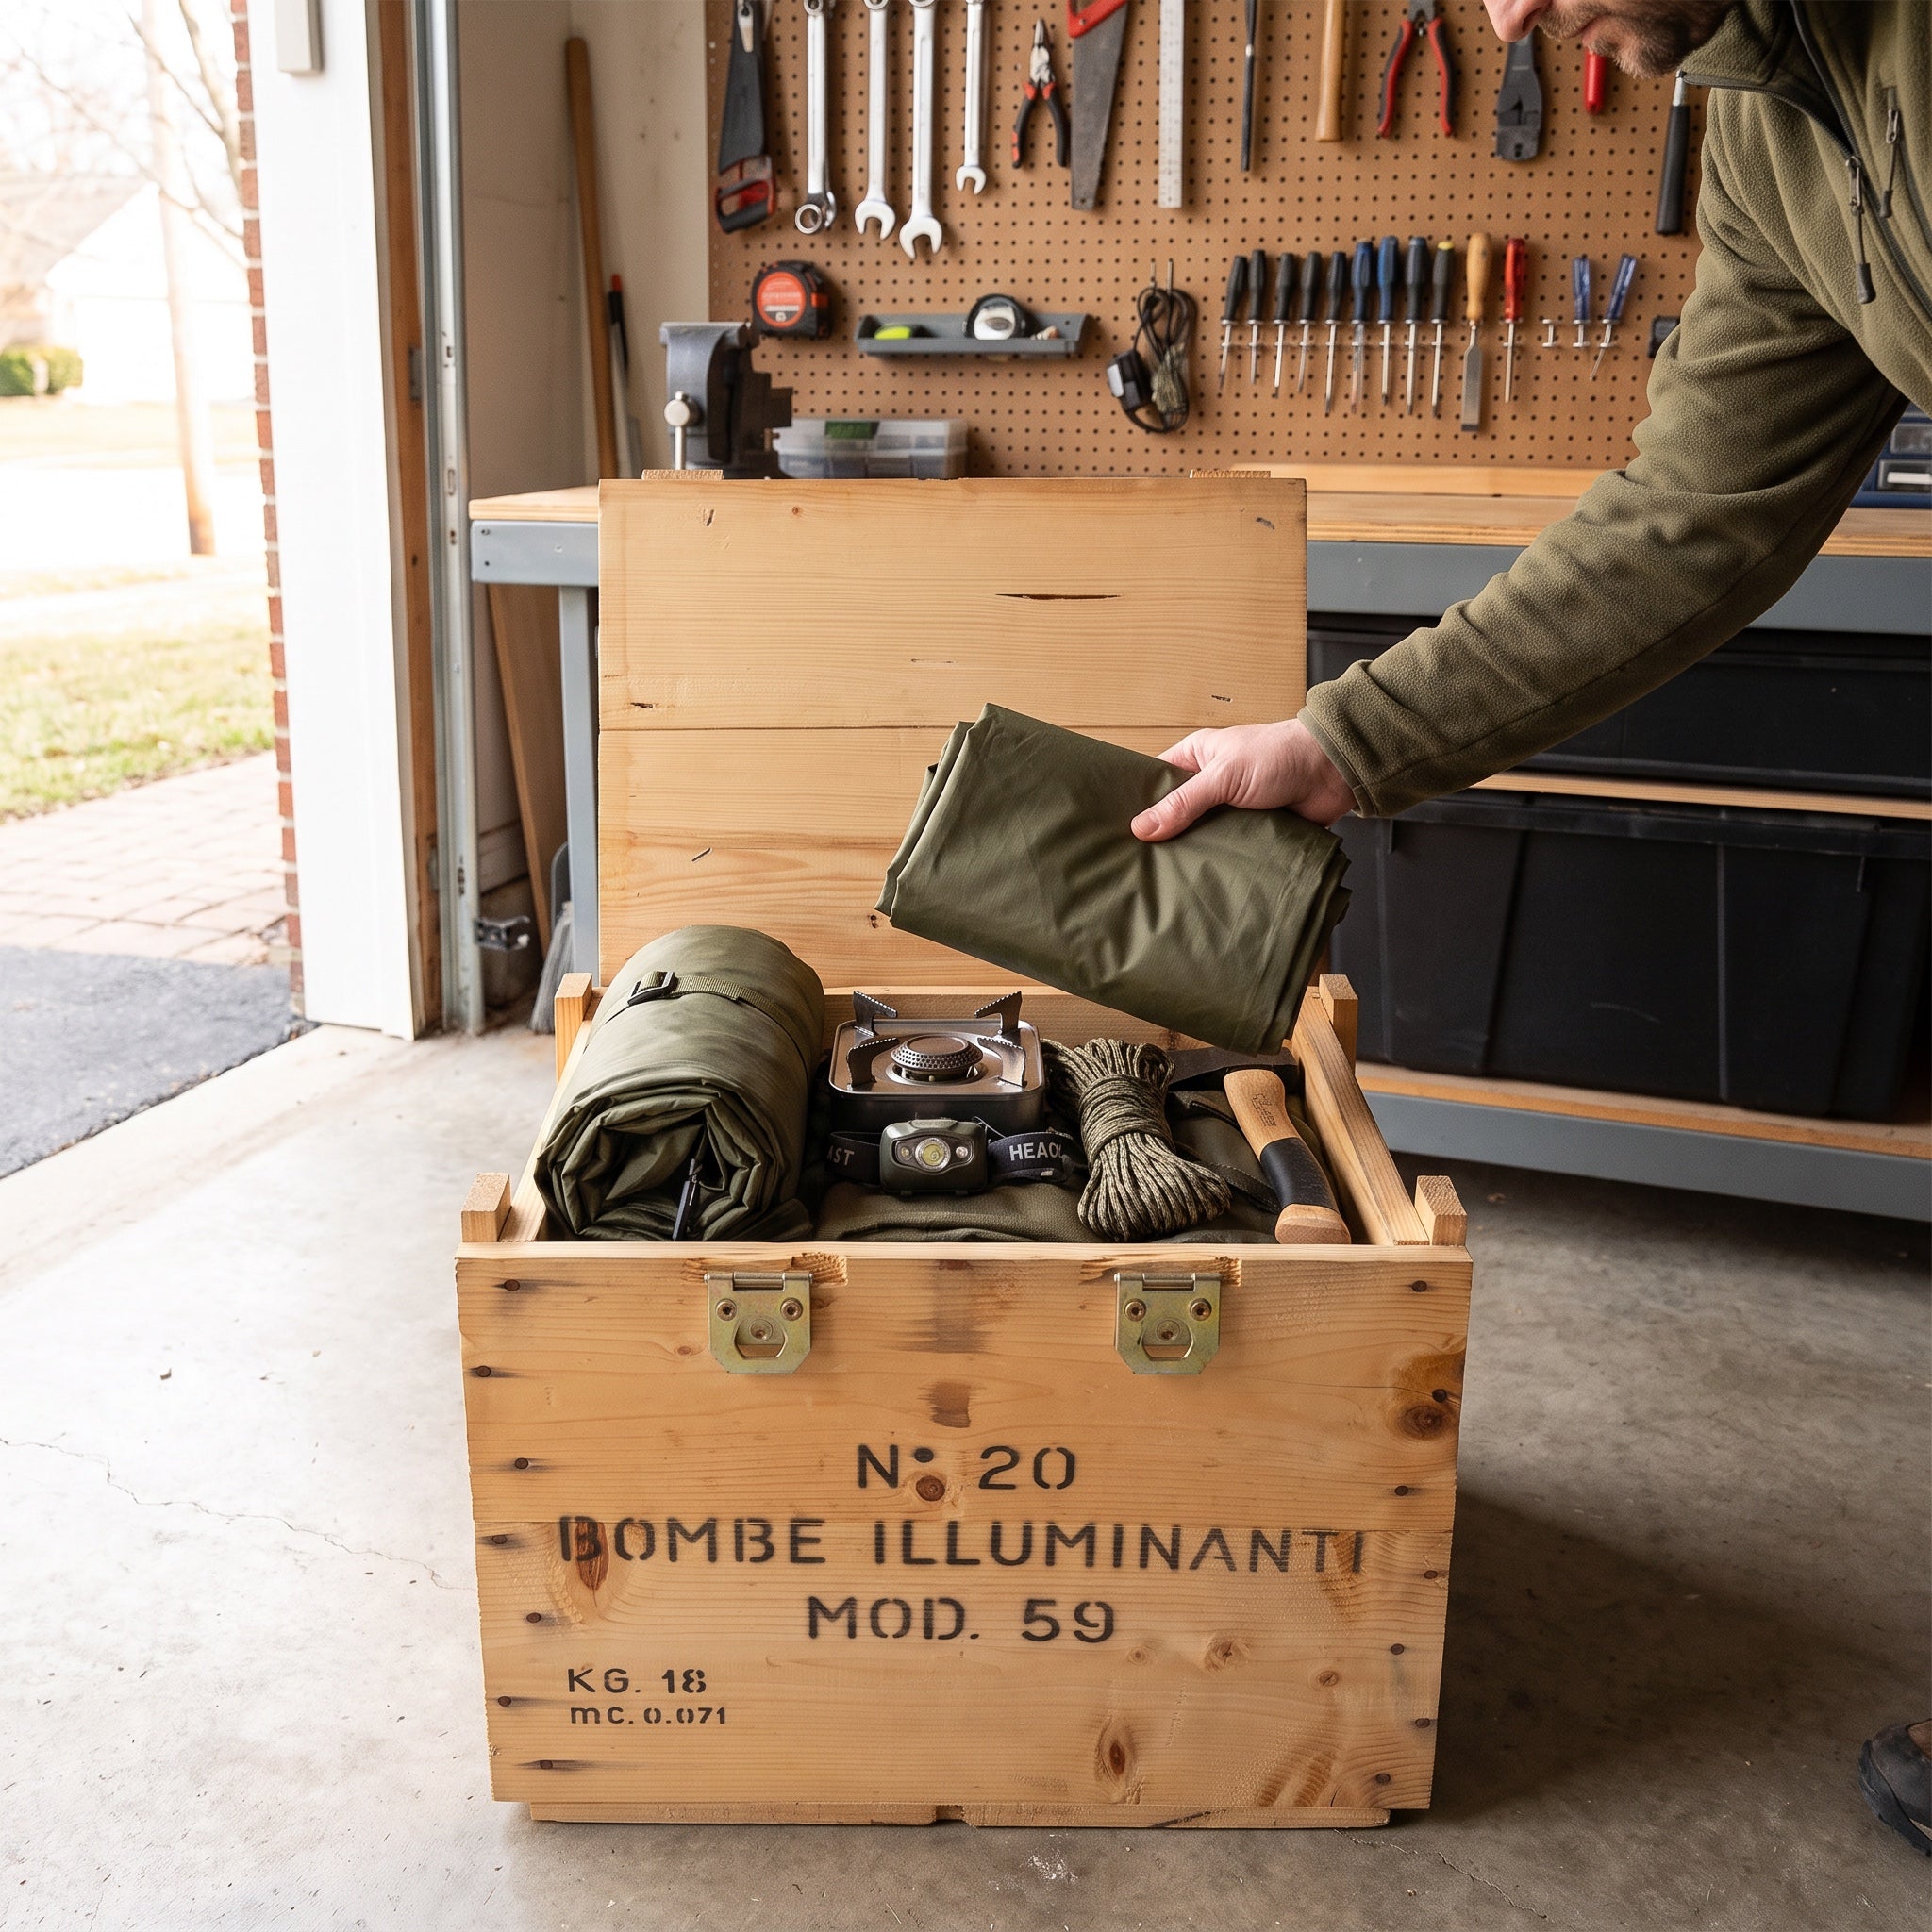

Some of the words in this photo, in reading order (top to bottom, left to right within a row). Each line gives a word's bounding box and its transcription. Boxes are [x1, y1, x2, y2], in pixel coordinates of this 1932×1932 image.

[978, 1445, 1076, 1490] 20
[559, 1515, 826, 1563] BOMBE
[874, 1519, 1365, 1574] ILLUMINANTI
[808, 1596, 980, 1641] MOD.
[1021, 1599, 1116, 1643] 59
[567, 1667, 642, 1693] KG.
[660, 1667, 708, 1694] 18
[642, 1706, 726, 1724] 0.071
